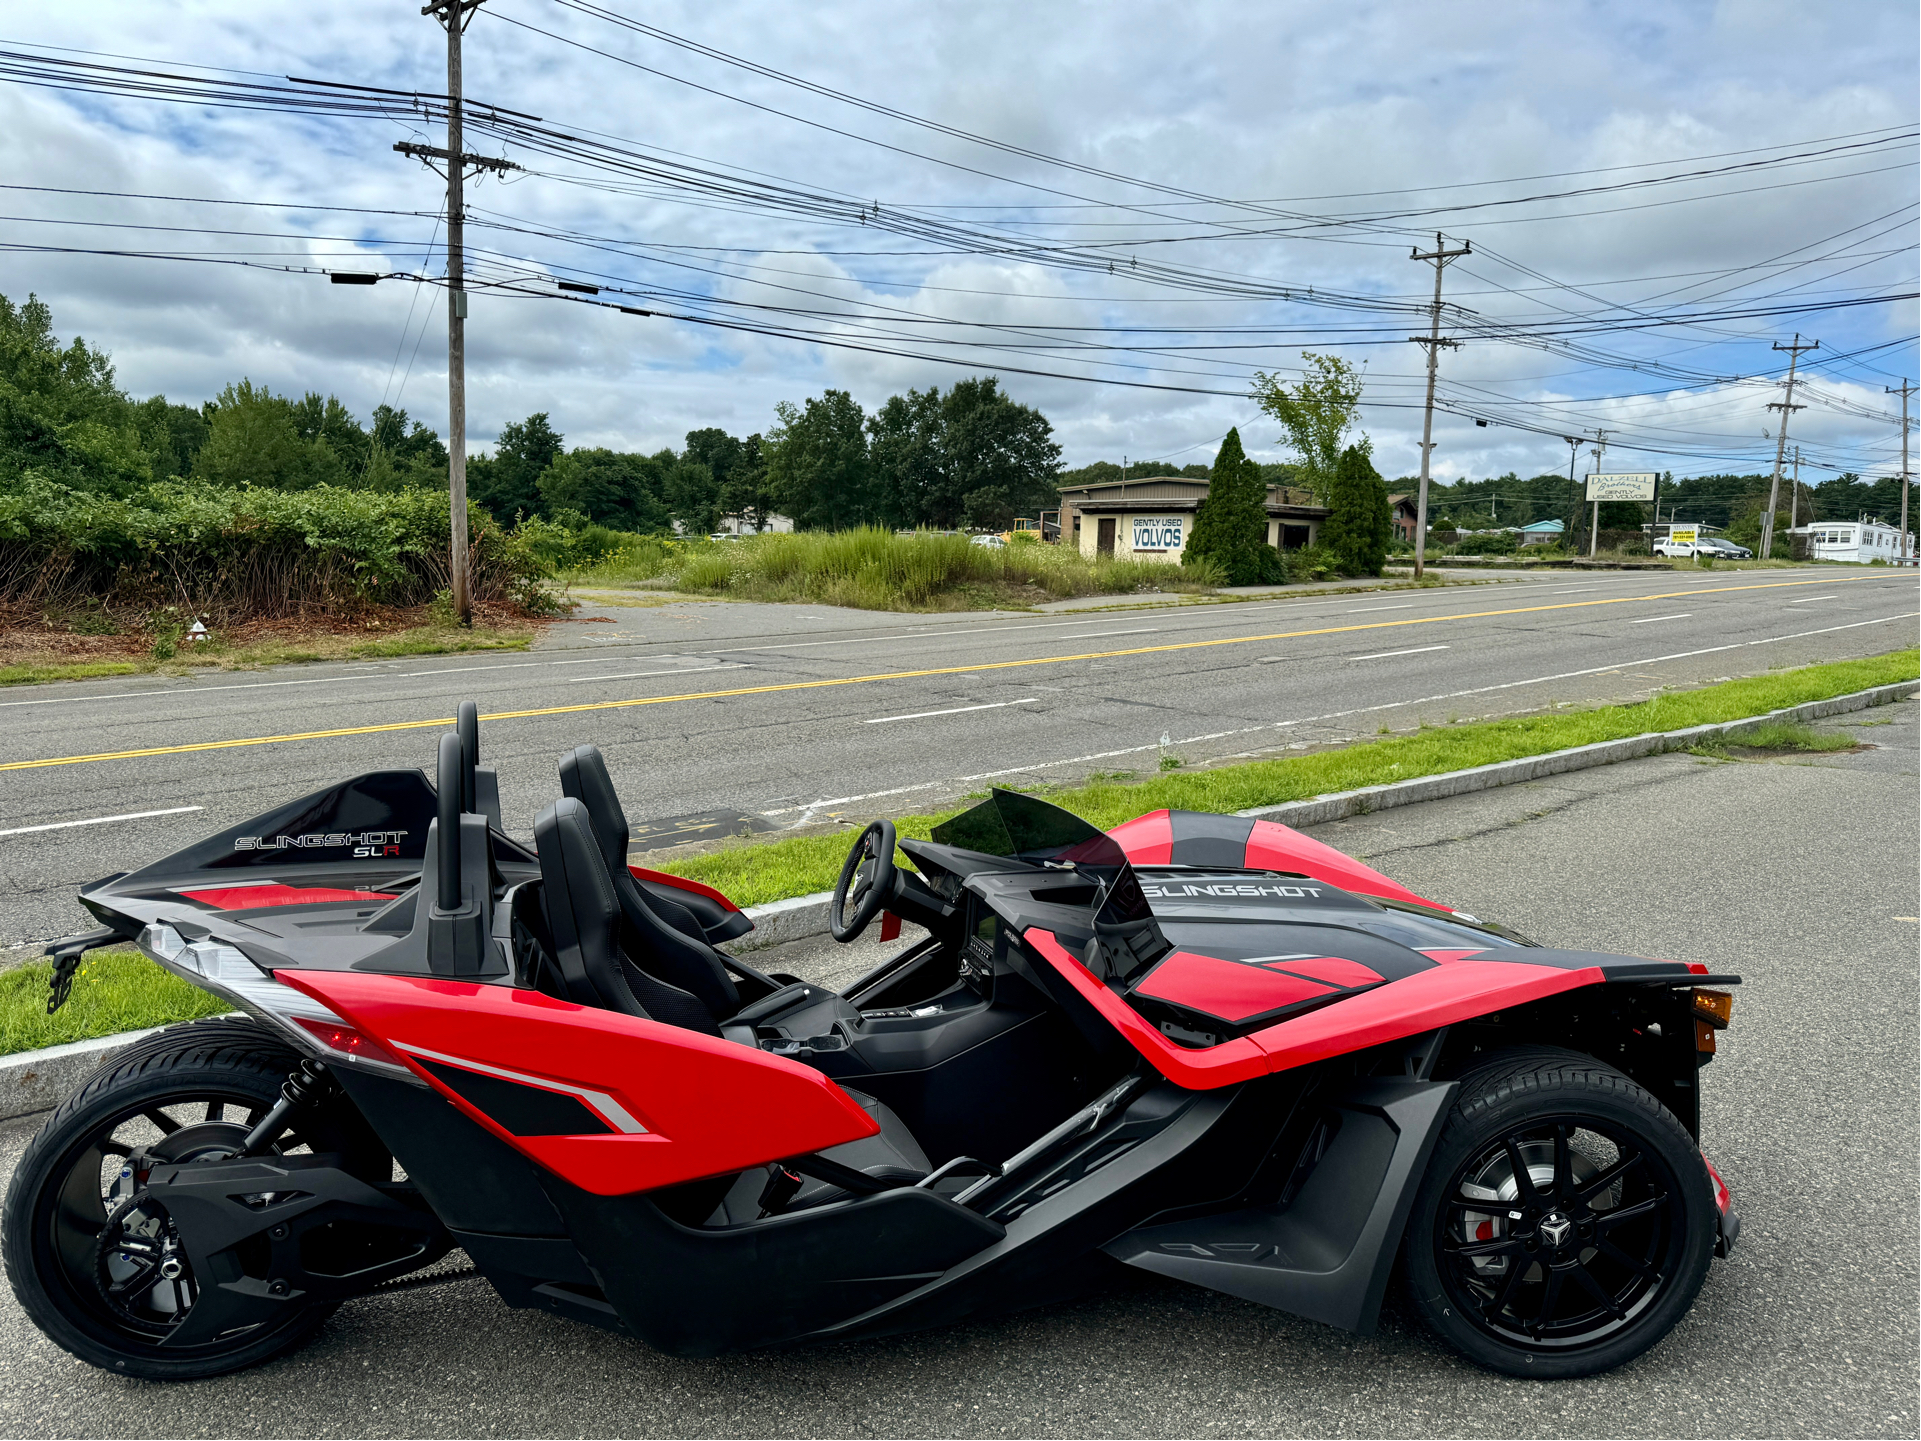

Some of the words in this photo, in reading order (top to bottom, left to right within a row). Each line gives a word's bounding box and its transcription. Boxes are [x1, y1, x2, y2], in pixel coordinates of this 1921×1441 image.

[1591, 476, 1652, 485] DALZELL
[1597, 481, 1642, 492] Brothers
[1133, 518, 1161, 527] GENTLY
[1161, 518, 1183, 527] USED
[1133, 528, 1182, 547] VOLVOS
[234, 830, 409, 851] SLINGSHOT
[352, 845, 400, 858] SLR
[1142, 884, 1323, 898] SLINGSHOT
